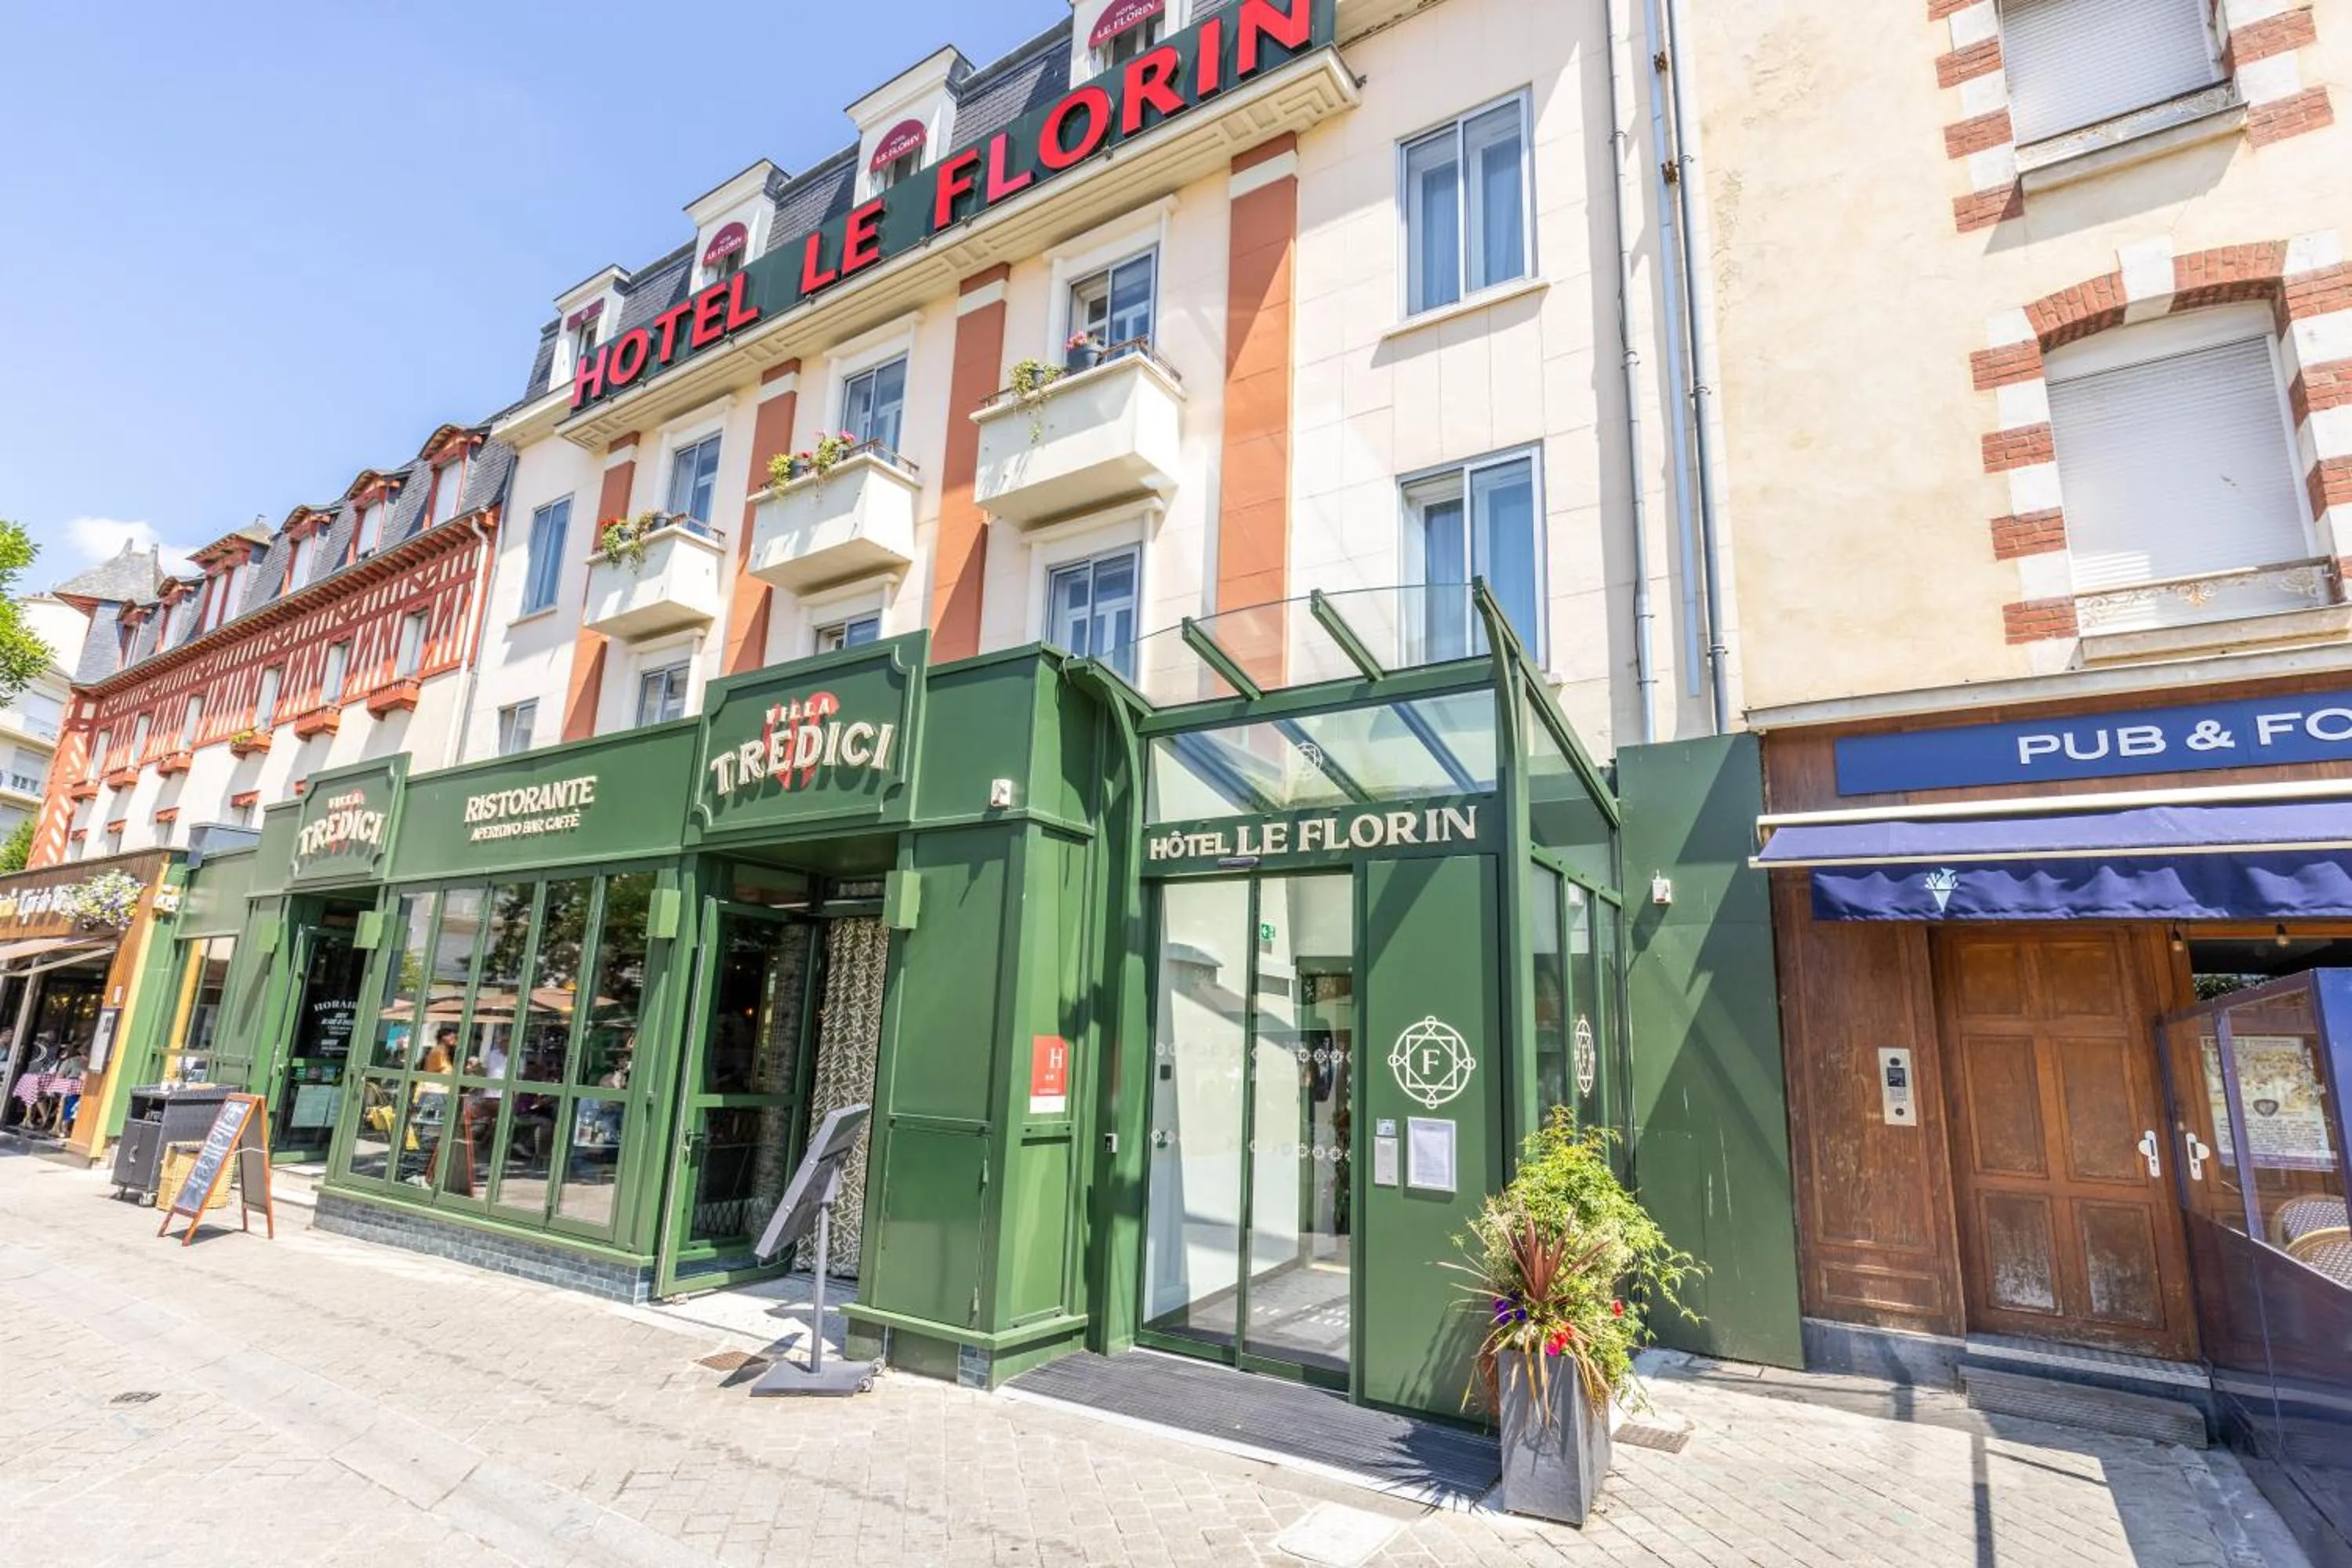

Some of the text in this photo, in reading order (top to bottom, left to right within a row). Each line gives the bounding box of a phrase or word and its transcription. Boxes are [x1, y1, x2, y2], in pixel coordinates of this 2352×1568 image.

[1098, 0, 1156, 38] LE FLORIN
[571, 0, 1312, 409] HOTEL LE FLORIN
[710, 720, 895, 796] TREDICI
[2017, 725, 2166, 764] PUB
[2186, 720, 2236, 751] &
[464, 775, 598, 822] RISTORANTE
[299, 810, 386, 855] TREDICI
[521, 819, 544, 833] BAR
[1149, 805, 1479, 861] HÔTEL LE FLORIN
[1050, 1047, 1062, 1070] H
[1421, 1048, 1440, 1075] F
